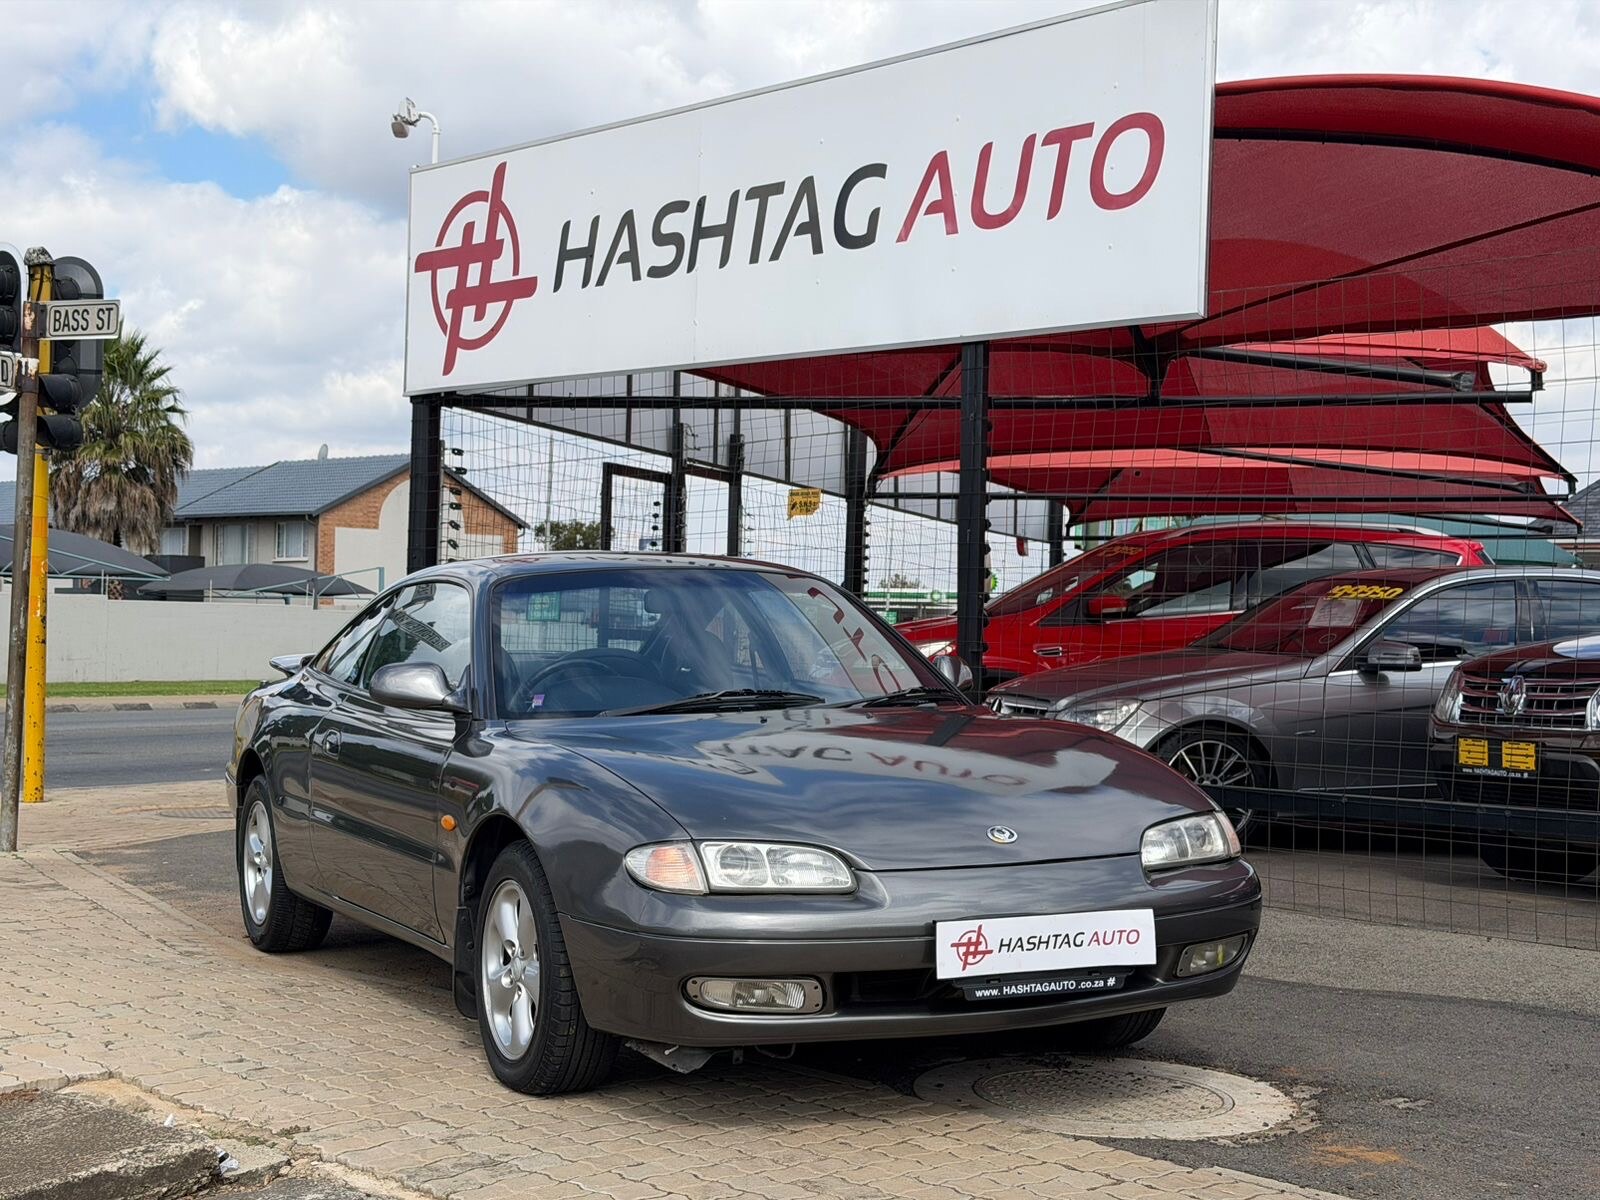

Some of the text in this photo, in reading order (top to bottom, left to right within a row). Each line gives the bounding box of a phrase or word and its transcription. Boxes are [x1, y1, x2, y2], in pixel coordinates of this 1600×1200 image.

[552, 112, 1165, 293] HASHTAG AUTO
[53, 307, 114, 332] BASS ST
[998, 929, 1141, 954] HASHTAG AUTO
[975, 989, 1001, 998] www.
[1003, 981, 1076, 995] HASHTAGAUTO
[1078, 979, 1104, 989] .co.za
